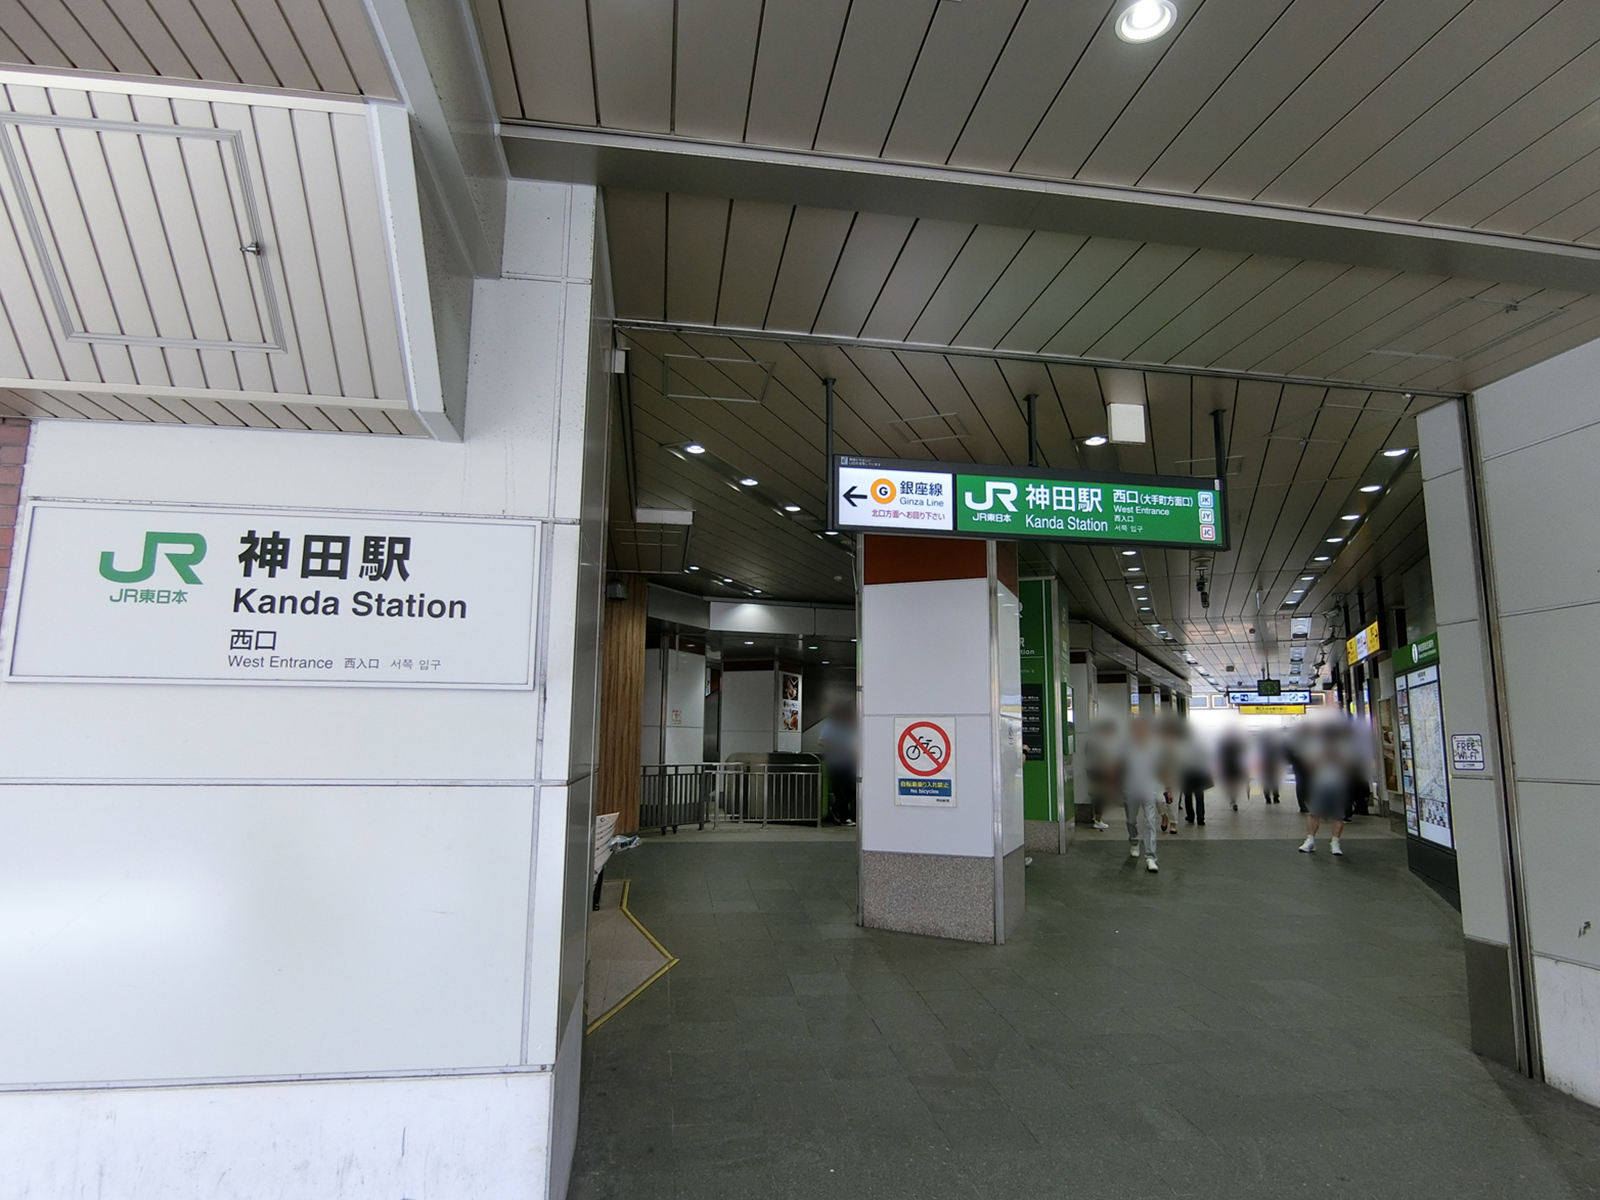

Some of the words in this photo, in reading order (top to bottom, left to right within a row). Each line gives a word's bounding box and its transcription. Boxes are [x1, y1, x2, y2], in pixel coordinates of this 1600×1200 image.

[879, 486, 889, 497] G
[900, 480, 943, 497] 銀座線
[900, 497, 924, 506] Ginza
[926, 498, 944, 507] Line
[964, 481, 1019, 513] JR
[1025, 483, 1103, 513] 神田駅
[871, 509, 946, 521] 北口方面へお回り下さい
[1113, 505, 1134, 514] West
[1135, 506, 1170, 516] Entrance
[1202, 512, 1210, 520] JY
[972, 512, 1012, 523] JR東日本
[1025, 514, 1064, 529] Kanda
[1067, 516, 1108, 531] Station
[1114, 515, 1134, 523] 西入口
[1203, 528, 1212, 536] JC
[99, 531, 207, 585] JR
[237, 529, 412, 582] 神田駅
[109, 588, 188, 604] JR東日本
[233, 588, 340, 615] Kanda
[351, 590, 467, 619] Station
[230, 629, 277, 651] 西口
[228, 655, 265, 668] West
[269, 656, 334, 669] Entrance
[344, 657, 380, 669] 西入口
[390, 658, 414, 670] 서쪽
[418, 659, 442, 671] 입구
[1456, 742, 1476, 751] FREE
[1458, 751, 1477, 760] Wi-Fi
